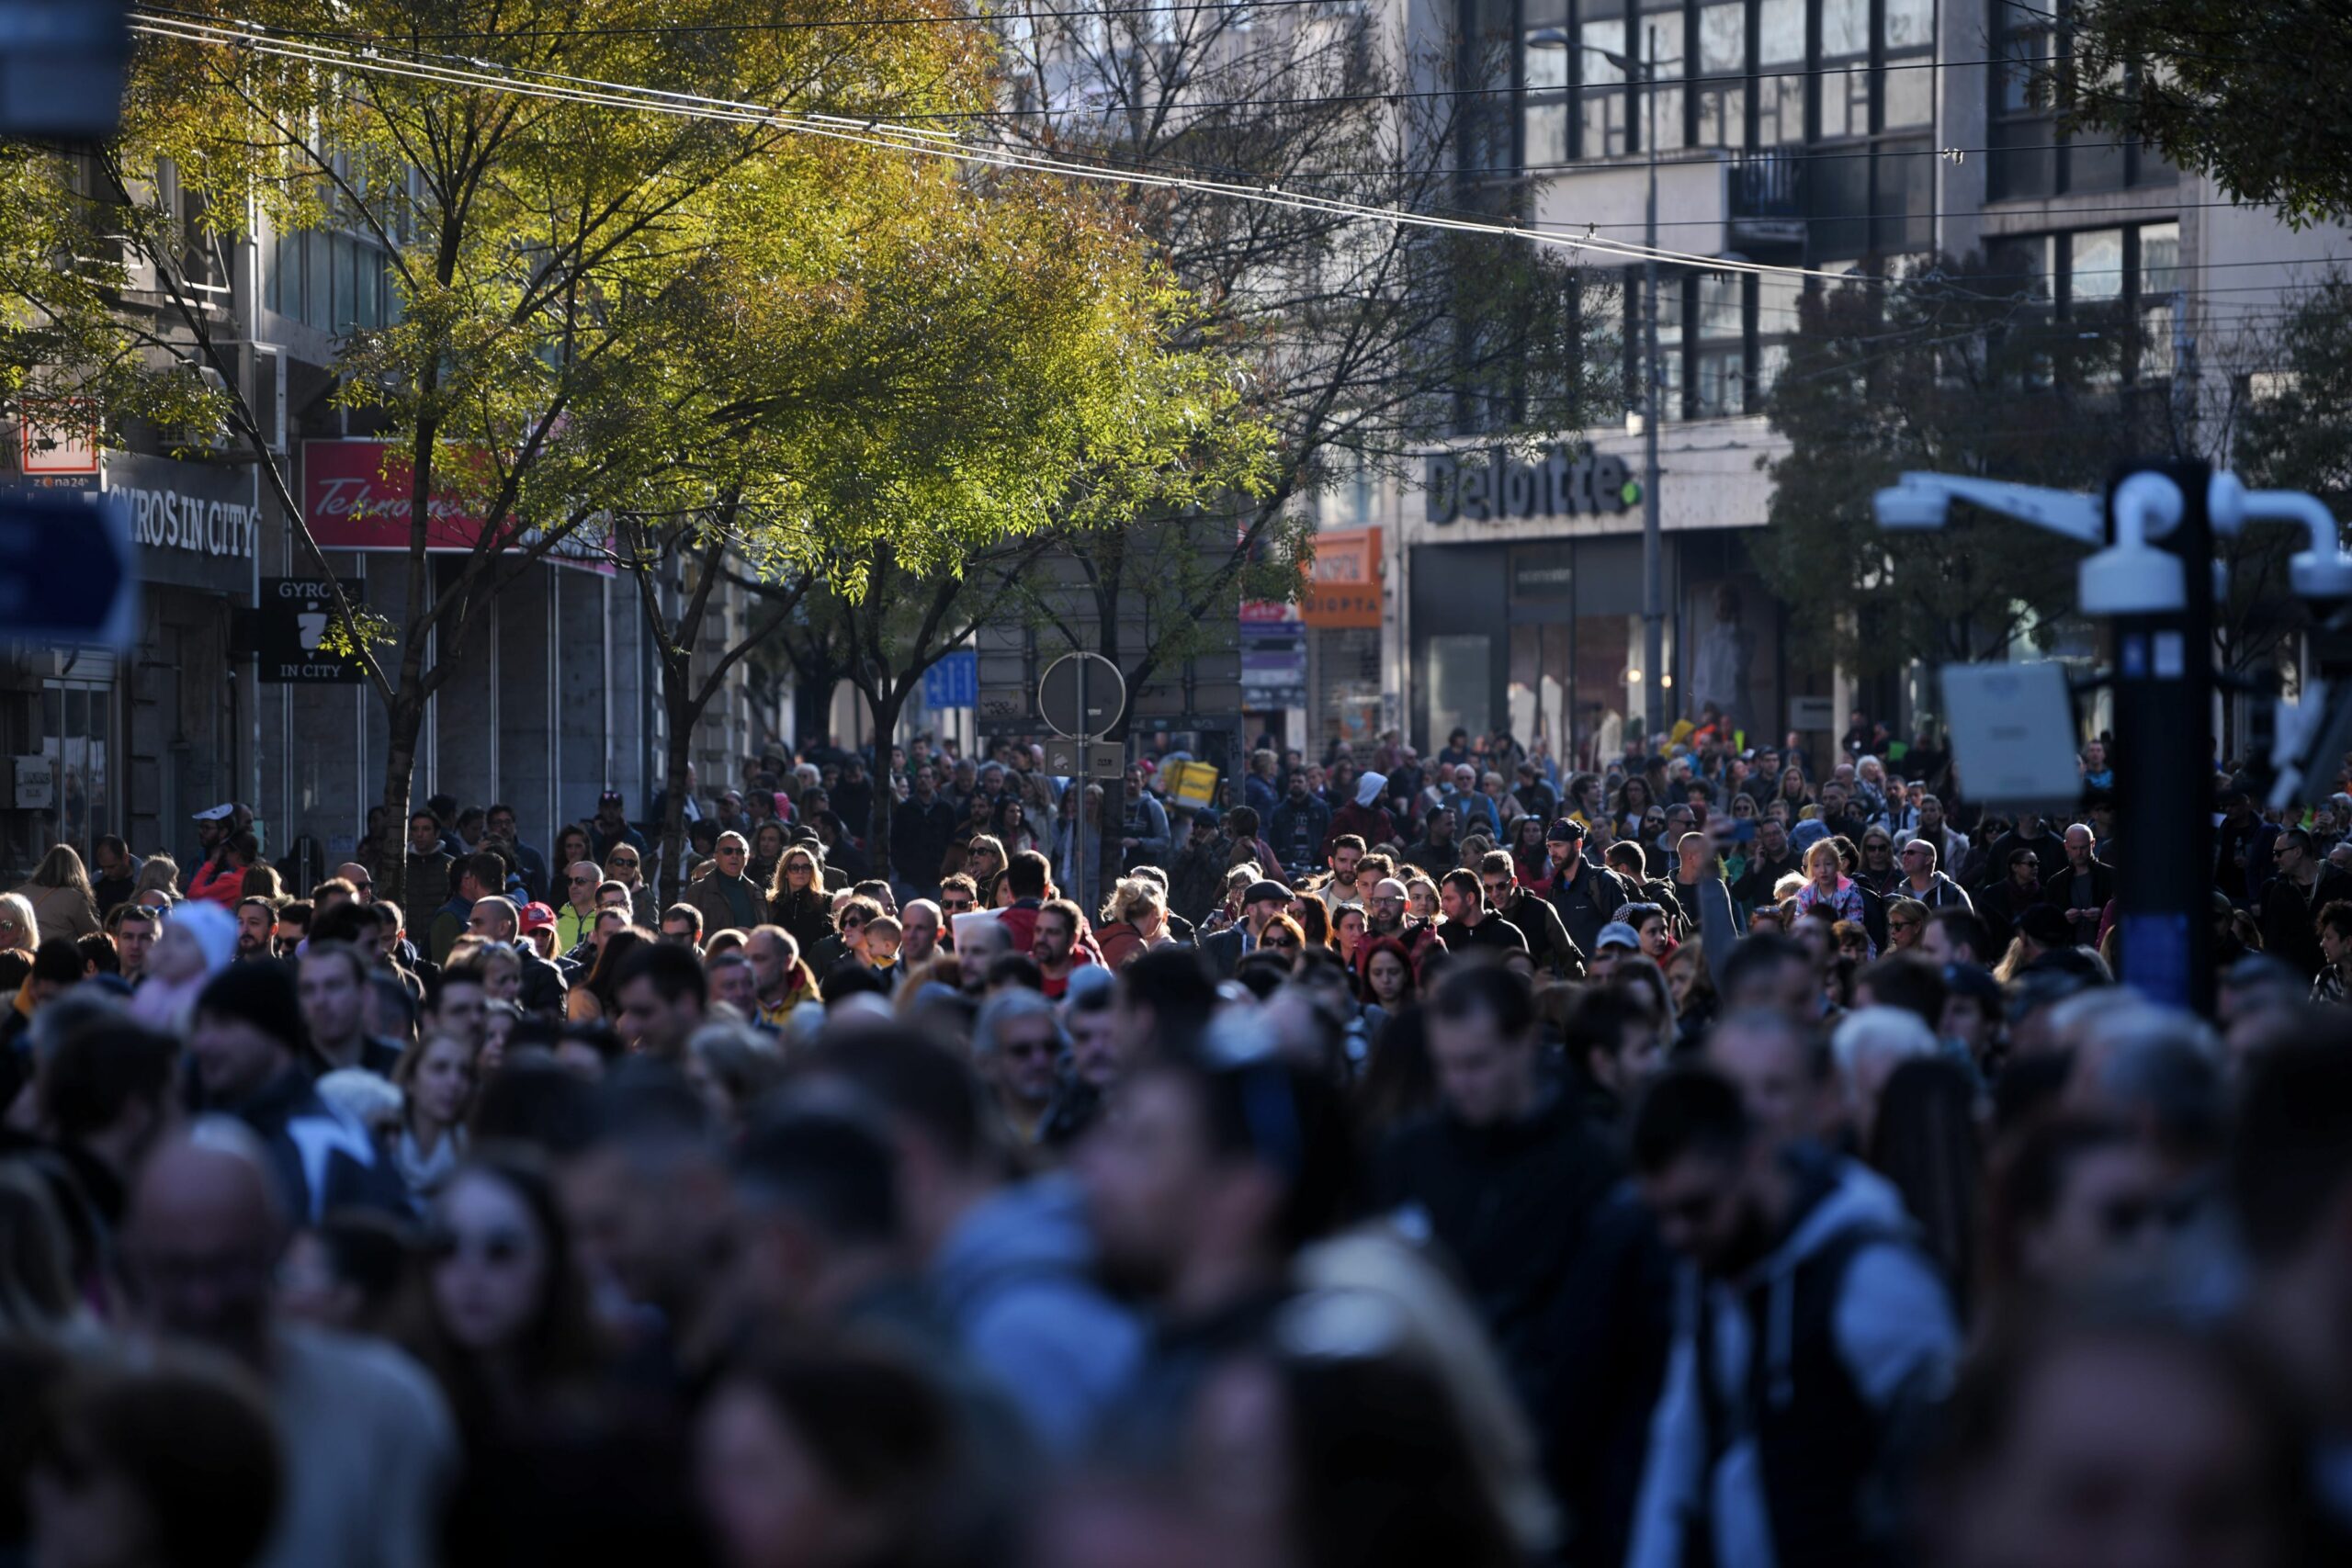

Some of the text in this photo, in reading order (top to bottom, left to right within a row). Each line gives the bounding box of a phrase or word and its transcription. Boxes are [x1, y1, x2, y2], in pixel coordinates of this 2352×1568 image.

[181, 496, 204, 551] IN
[208, 501, 256, 558] CITY
[278, 581, 344, 598] GYRO
[279, 664, 342, 677] IN CITY
